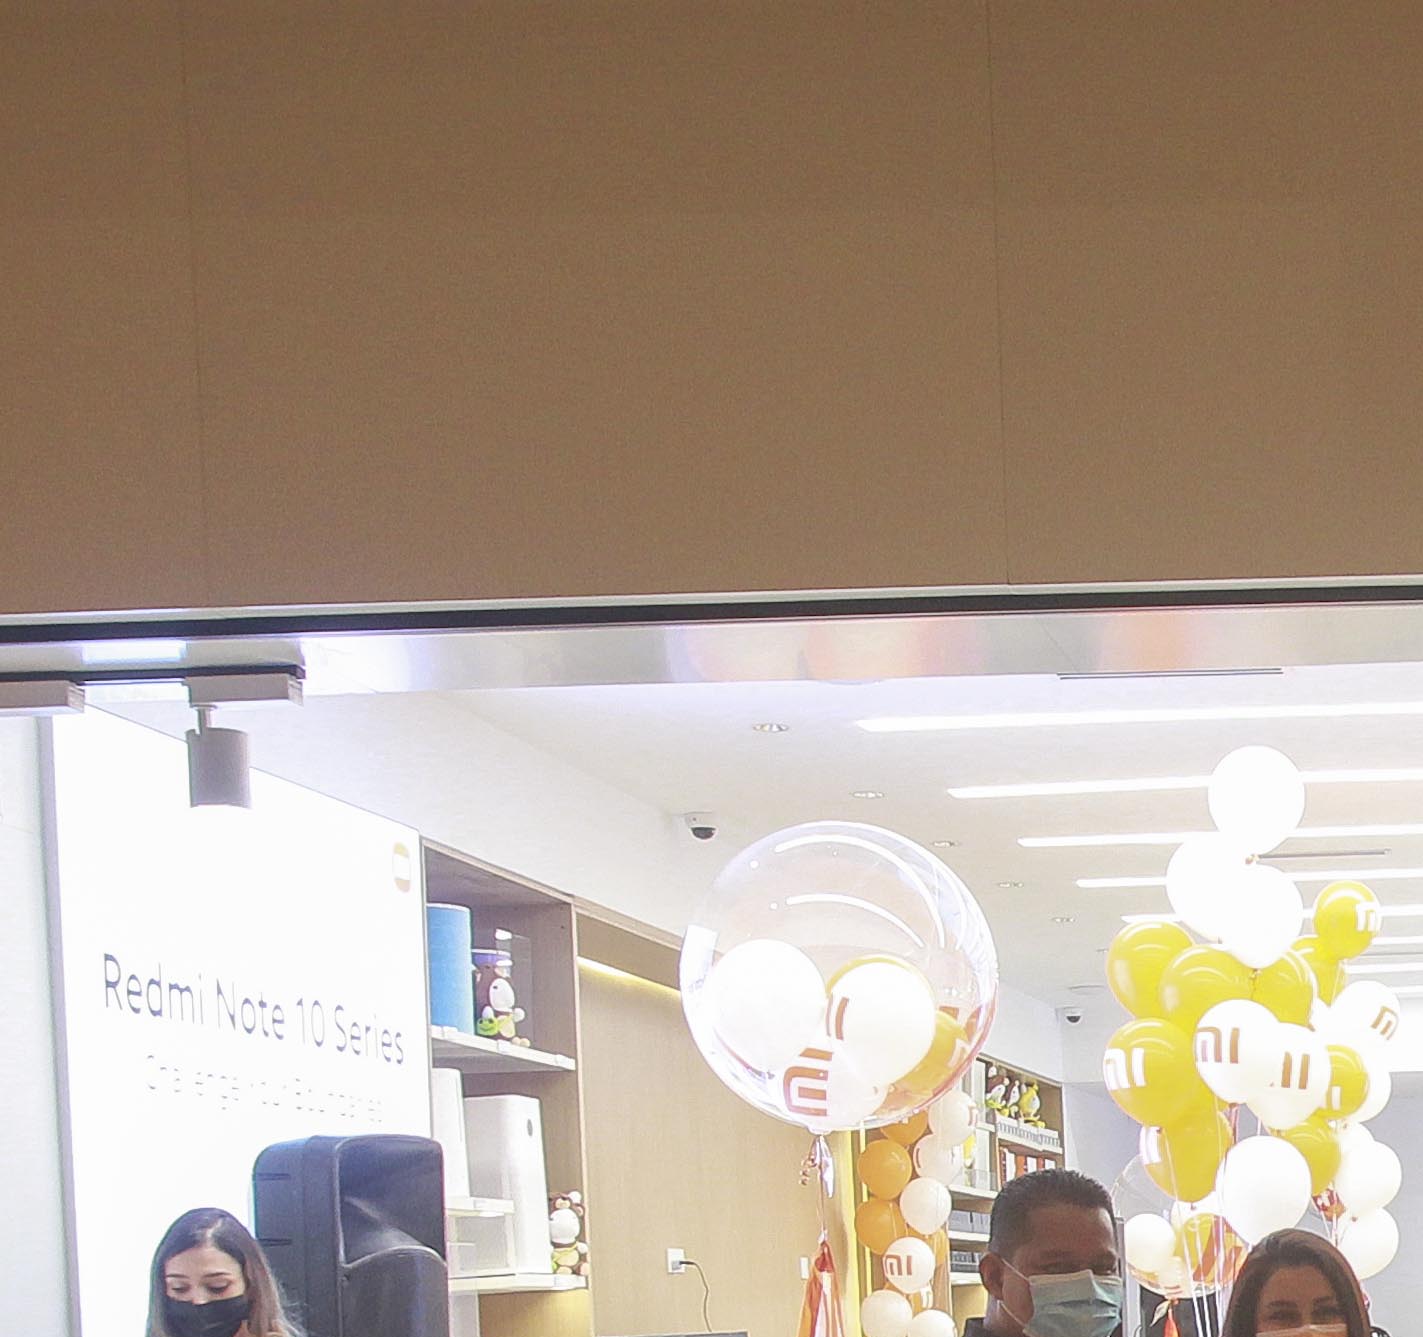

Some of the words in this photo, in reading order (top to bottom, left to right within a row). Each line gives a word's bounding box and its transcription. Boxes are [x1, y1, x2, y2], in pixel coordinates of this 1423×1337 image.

[104, 953, 204, 1025] Redmi
[216, 978, 285, 1040] Note
[296, 997, 326, 1047] 10
[334, 1004, 404, 1065] Series
